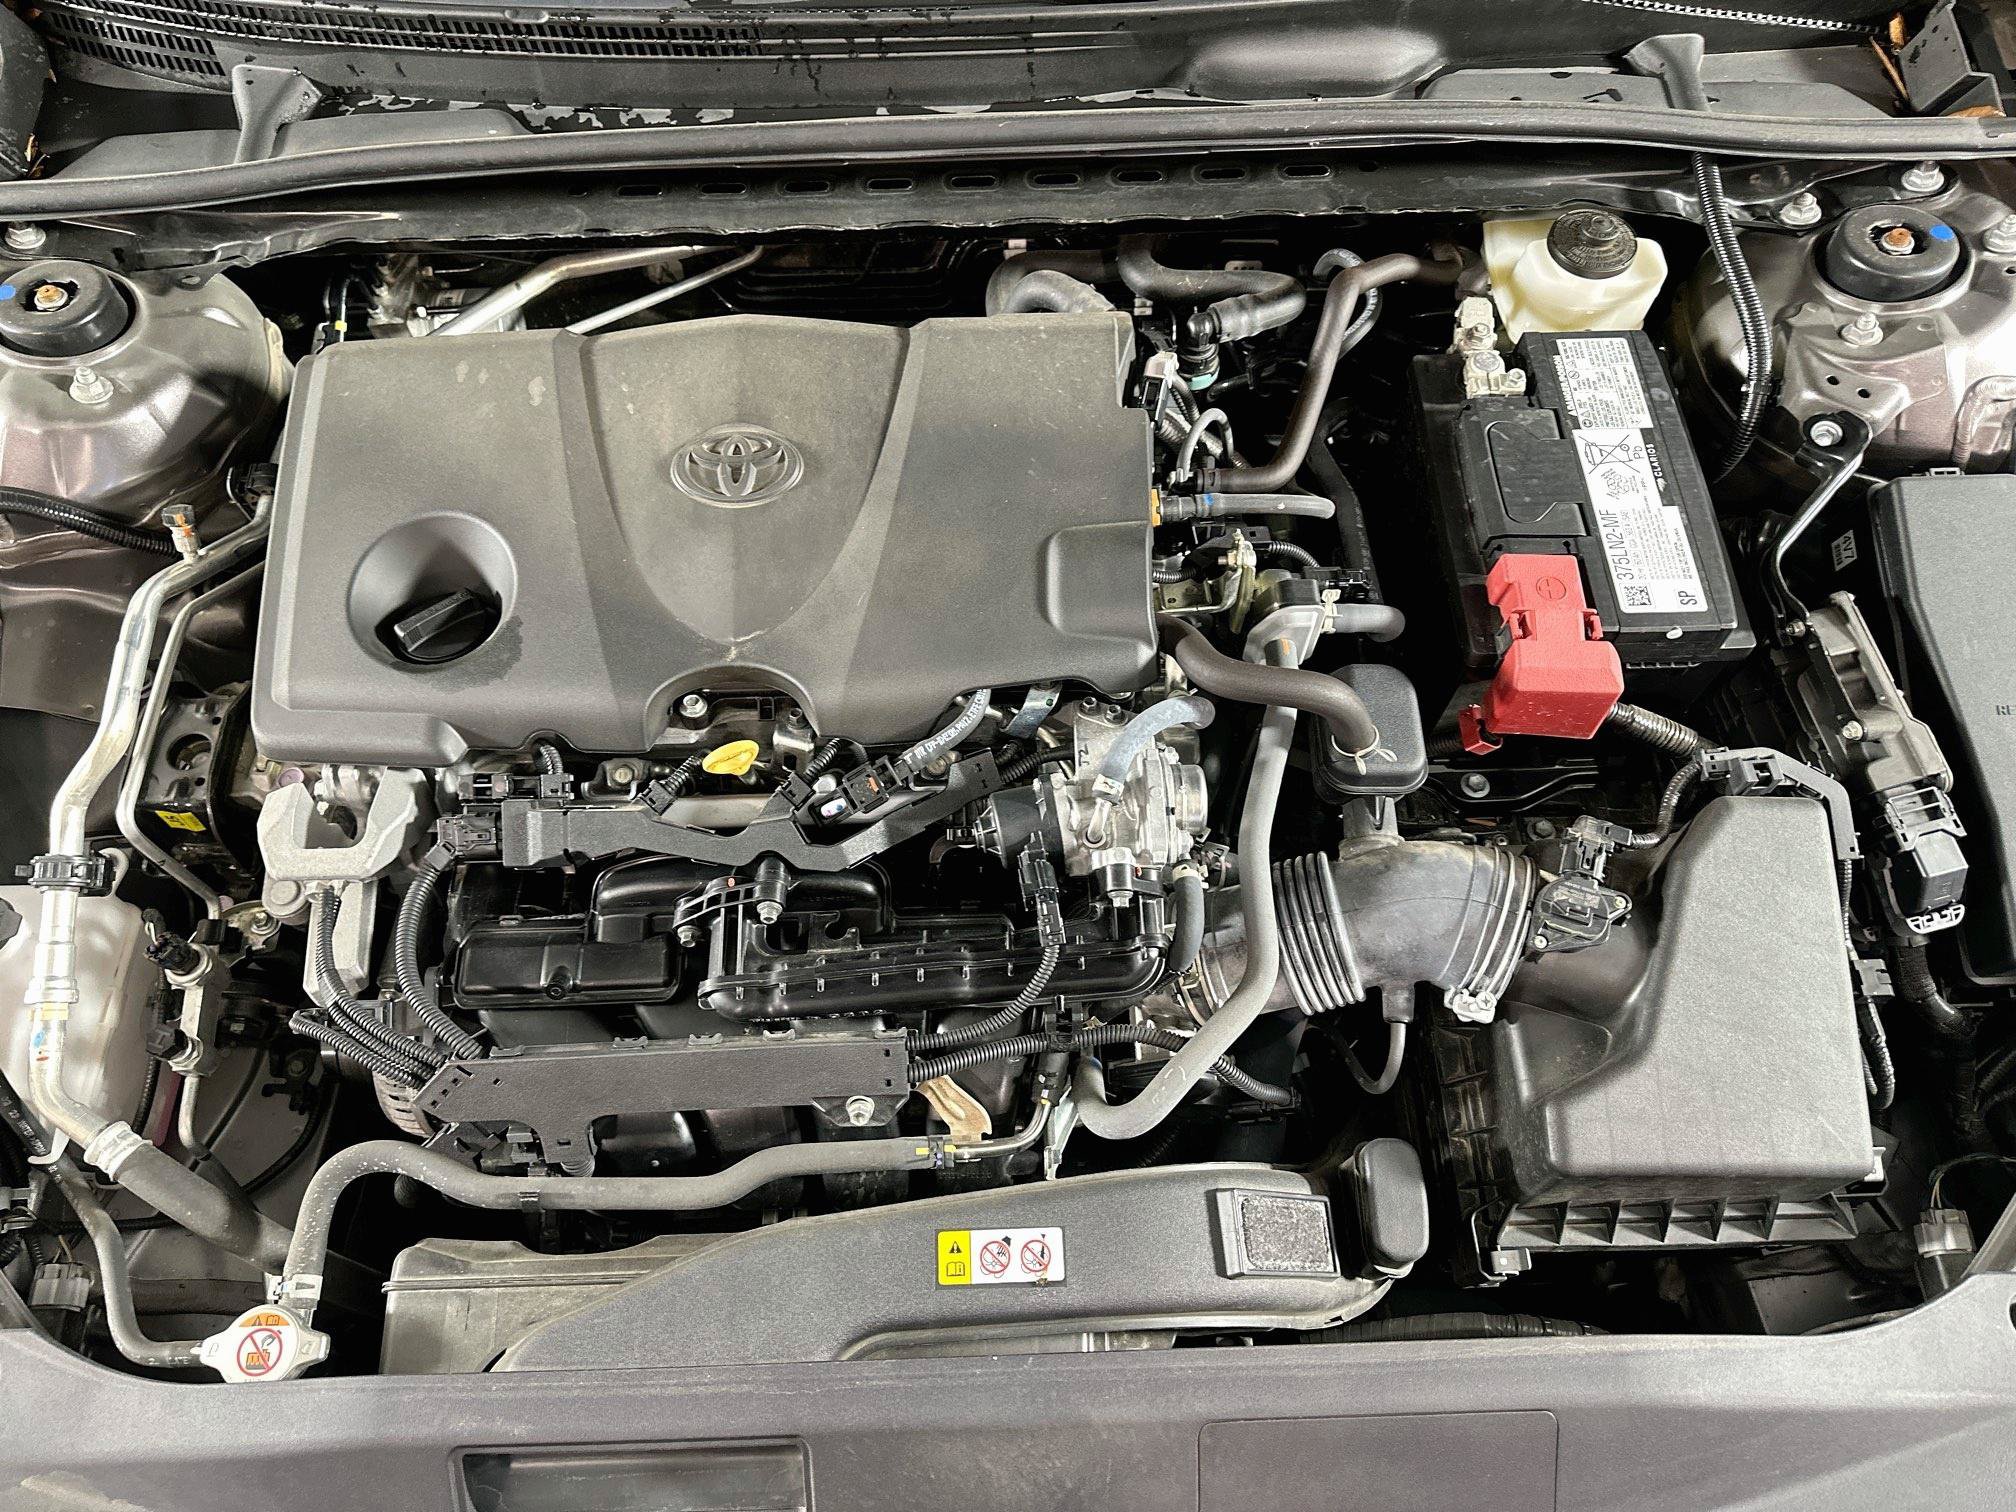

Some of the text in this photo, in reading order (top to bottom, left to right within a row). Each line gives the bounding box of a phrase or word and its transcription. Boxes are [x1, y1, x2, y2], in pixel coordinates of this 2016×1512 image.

[1633, 446, 1646, 459] Pb
[1645, 443, 1664, 477] CLARIOS
[1599, 509, 1634, 580] 375LN2-MF
[1678, 591, 1698, 606] SP
